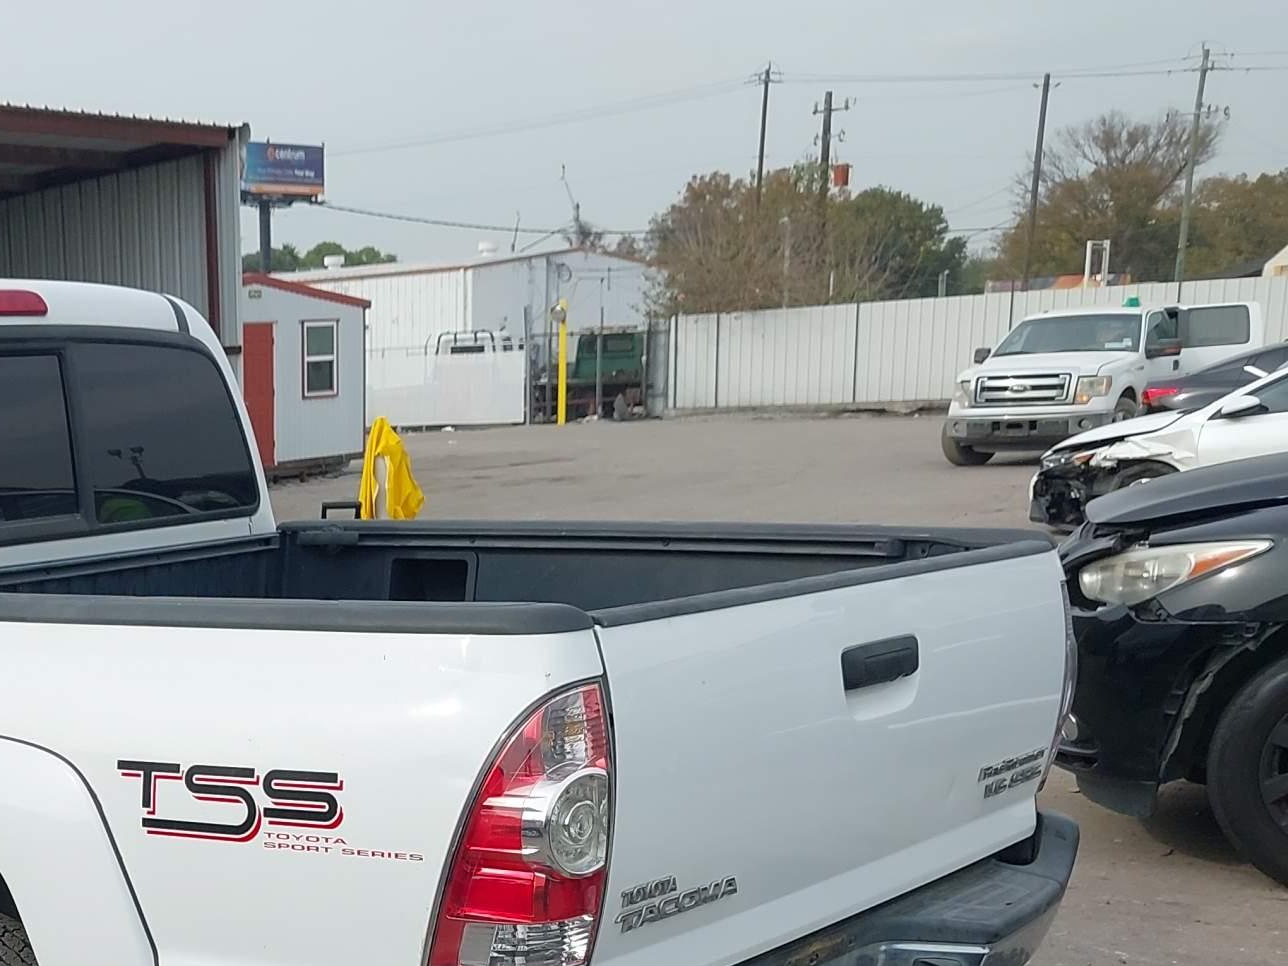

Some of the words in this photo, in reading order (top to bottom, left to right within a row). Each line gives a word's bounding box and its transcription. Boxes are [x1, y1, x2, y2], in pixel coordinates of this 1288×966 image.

[116, 759, 344, 843] TSS
[263, 831, 348, 846] TOYOTA
[263, 841, 334, 854] SPORT
[341, 847, 424, 861] SERIES
[614, 875, 738, 933] TACOMA
[620, 875, 678, 908] TOYOTA
